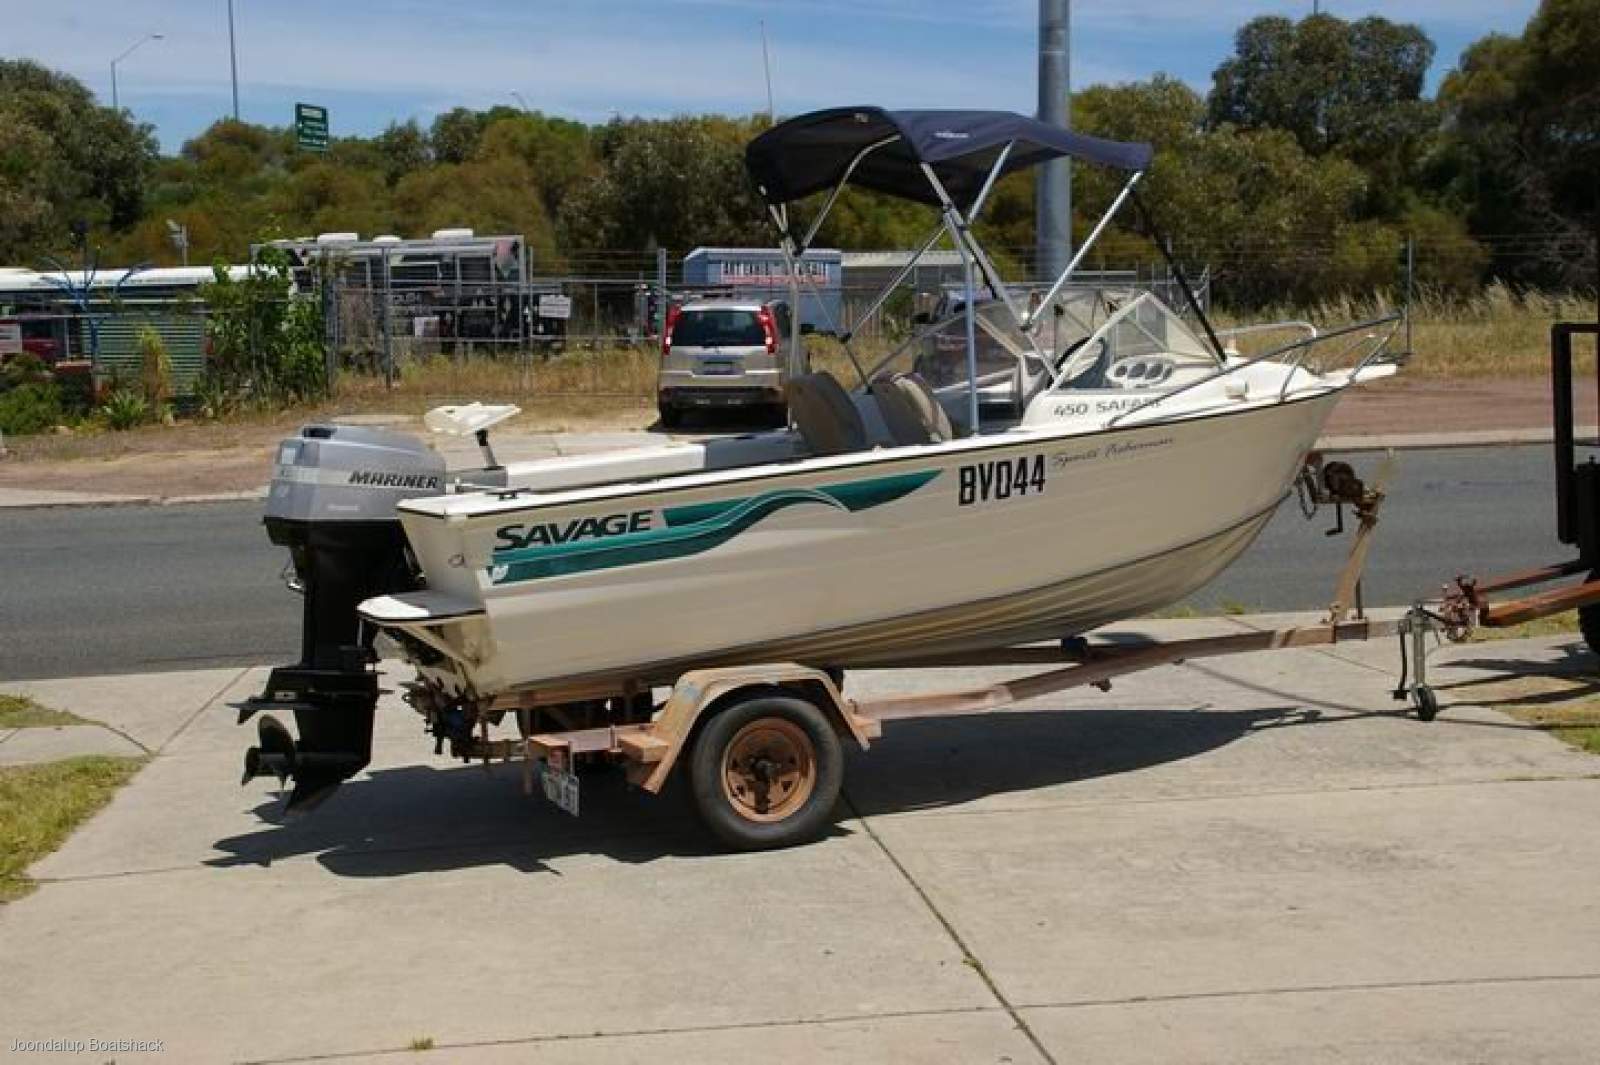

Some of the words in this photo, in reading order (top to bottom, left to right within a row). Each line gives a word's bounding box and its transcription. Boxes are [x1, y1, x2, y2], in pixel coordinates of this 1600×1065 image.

[1053, 402, 1088, 416] 450
[348, 470, 438, 489] MARINER
[958, 454, 1046, 505] BV044
[493, 509, 654, 551] SAVAGE
